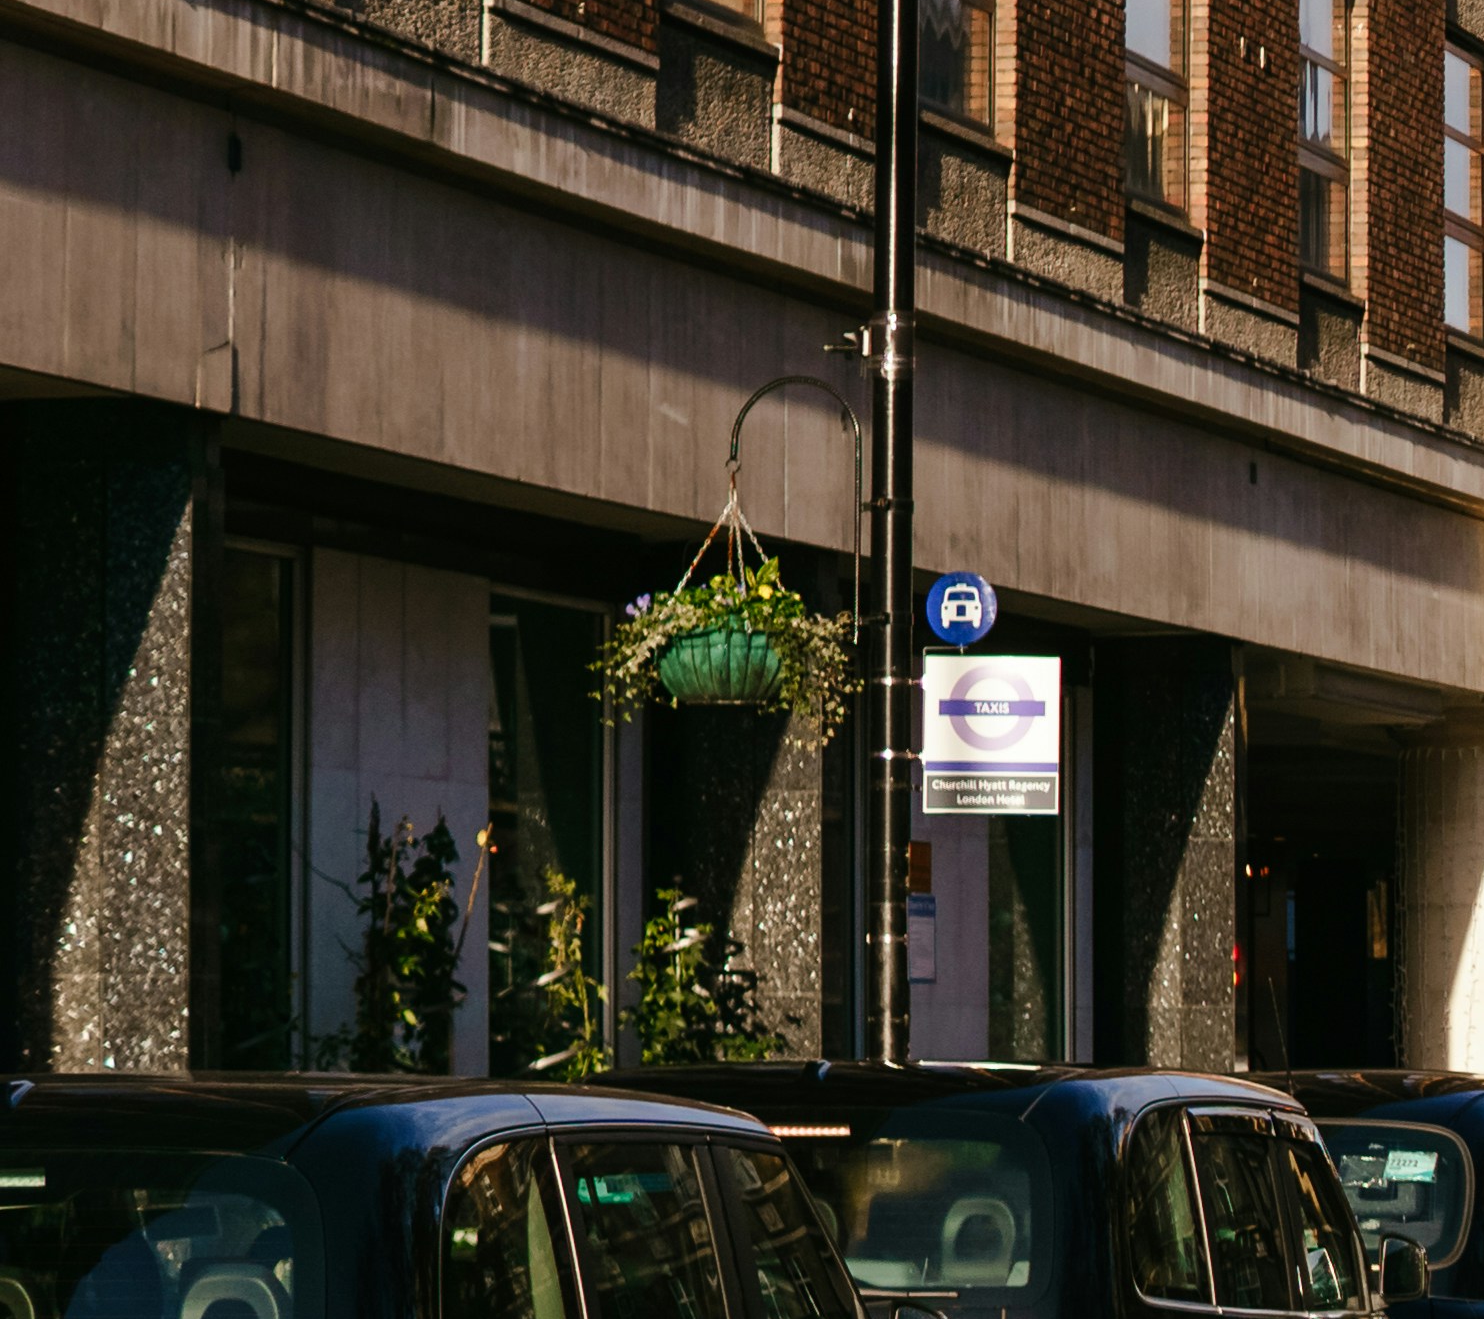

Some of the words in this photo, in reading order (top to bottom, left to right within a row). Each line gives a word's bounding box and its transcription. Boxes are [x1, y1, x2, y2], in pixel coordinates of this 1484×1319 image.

[974, 702, 1010, 714] TAXIS
[931, 779, 977, 791] Churchill
[978, 779, 1006, 792] Hyatt
[1008, 780, 1051, 794] Regency
[956, 794, 994, 805] London
